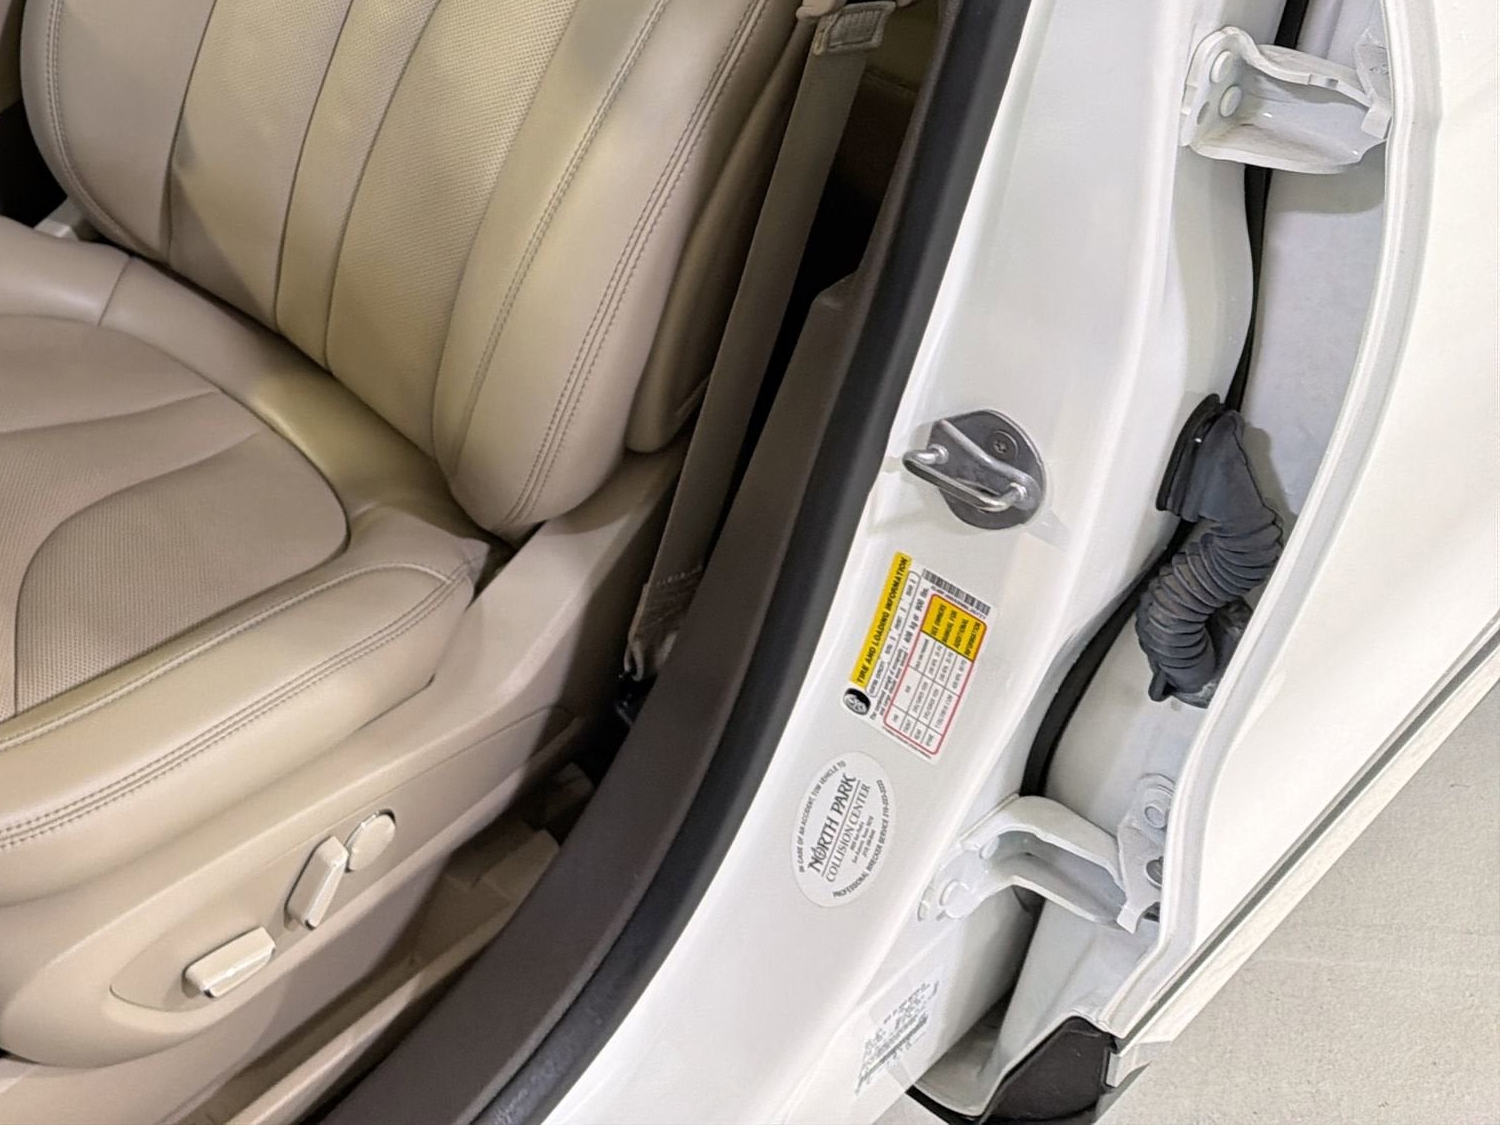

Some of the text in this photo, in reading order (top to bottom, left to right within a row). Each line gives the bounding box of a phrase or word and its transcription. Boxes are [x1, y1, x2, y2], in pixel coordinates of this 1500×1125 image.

[884, 556, 908, 612] INFORMATION
[871, 612, 890, 645] LOADING
[866, 646, 877, 665] AND
[856, 664, 870, 683] TIRE
[819, 765, 839, 785] VEHICLE
[808, 773, 856, 873] NORTH PARK
[825, 825, 854, 883] COLLISION
[848, 783, 871, 825] CENTER
